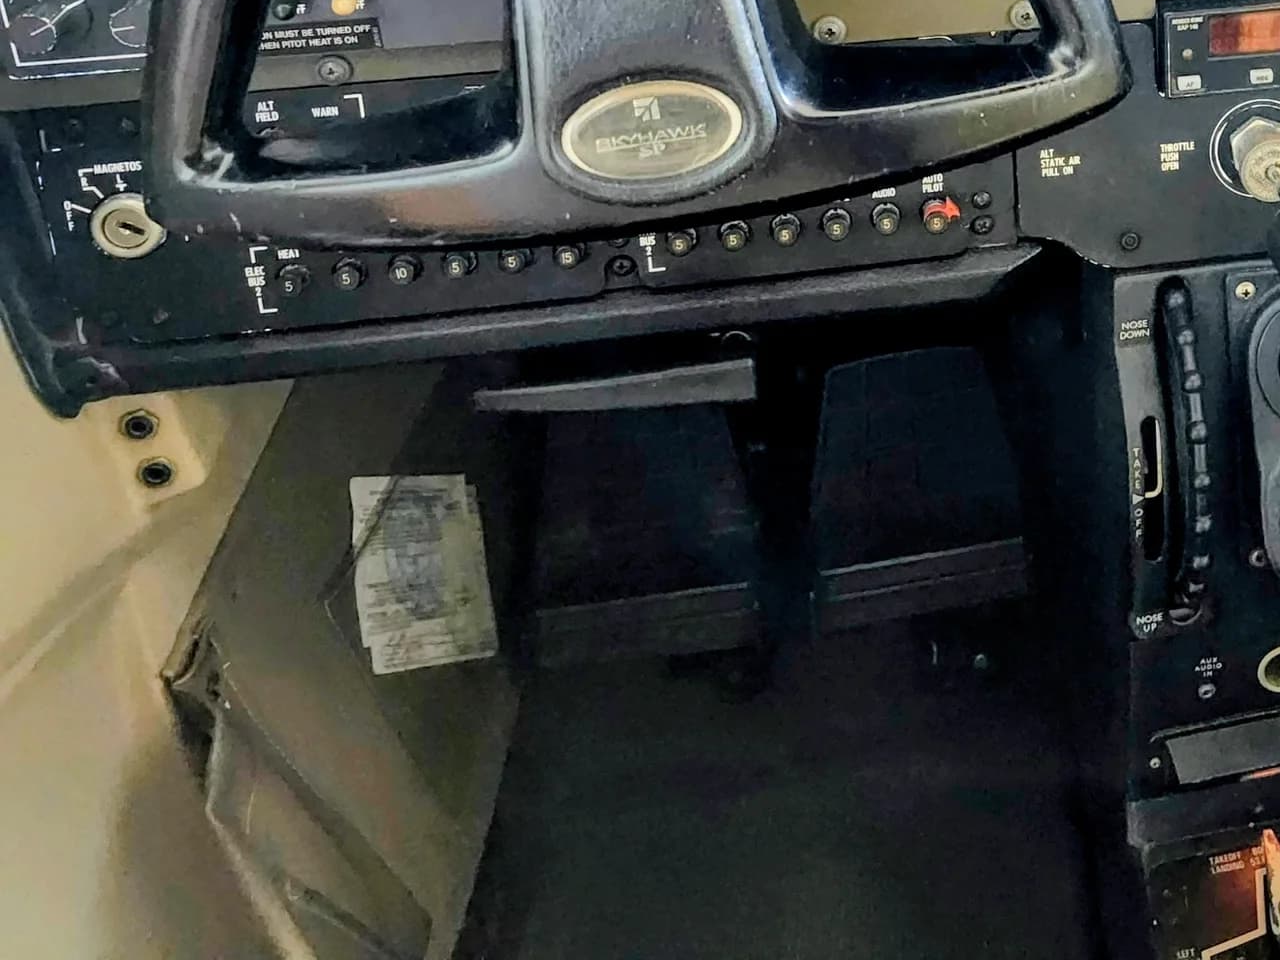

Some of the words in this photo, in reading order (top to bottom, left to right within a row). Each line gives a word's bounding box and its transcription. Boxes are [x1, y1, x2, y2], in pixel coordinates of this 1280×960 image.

[275, 30, 299, 39] MUST
[301, 29, 315, 37] BE
[315, 27, 352, 36] TURNED
[353, 25, 371, 33] OFF
[281, 40, 307, 49] PITOT
[308, 38, 332, 47] HEAT
[333, 37, 343, 46] IS
[344, 36, 358, 45] ON
[257, 101, 274, 112] ALT
[311, 106, 339, 118] WARN
[255, 111, 279, 123] FIELD
[638, 144, 666, 159] SP
[1160, 141, 1195, 152] THROTTLE
[1040, 149, 1054, 158] ALT
[1160, 152, 1179, 162] PUSH
[93, 161, 142, 174] MAGNETOS
[1040, 157, 1066, 168] STATIC
[1068, 156, 1081, 166] AIR
[1161, 161, 1179, 171] OPEN
[1042, 167, 1060, 177] PULL
[1063, 166, 1073, 175] ON
[922, 182, 944, 193] PILOT
[872, 188, 896, 199] AUDIO
[561, 252, 573, 263] 15
[245, 267, 265, 278] ELEC
[395, 268, 407, 279] 10
[248, 277, 265, 287] BUS
[342, 274, 350, 284] 5
[285, 281, 293, 292] 5
[1121, 319, 1149, 330] NOSE
[1119, 328, 1151, 340] DOWN
[1132, 446, 1143, 492] TAKE
[1136, 613, 1163, 626] NOSE
[1143, 623, 1158, 633] UP
[1200, 657, 1218, 665] AUX
[1194, 662, 1223, 672] AUDIO
